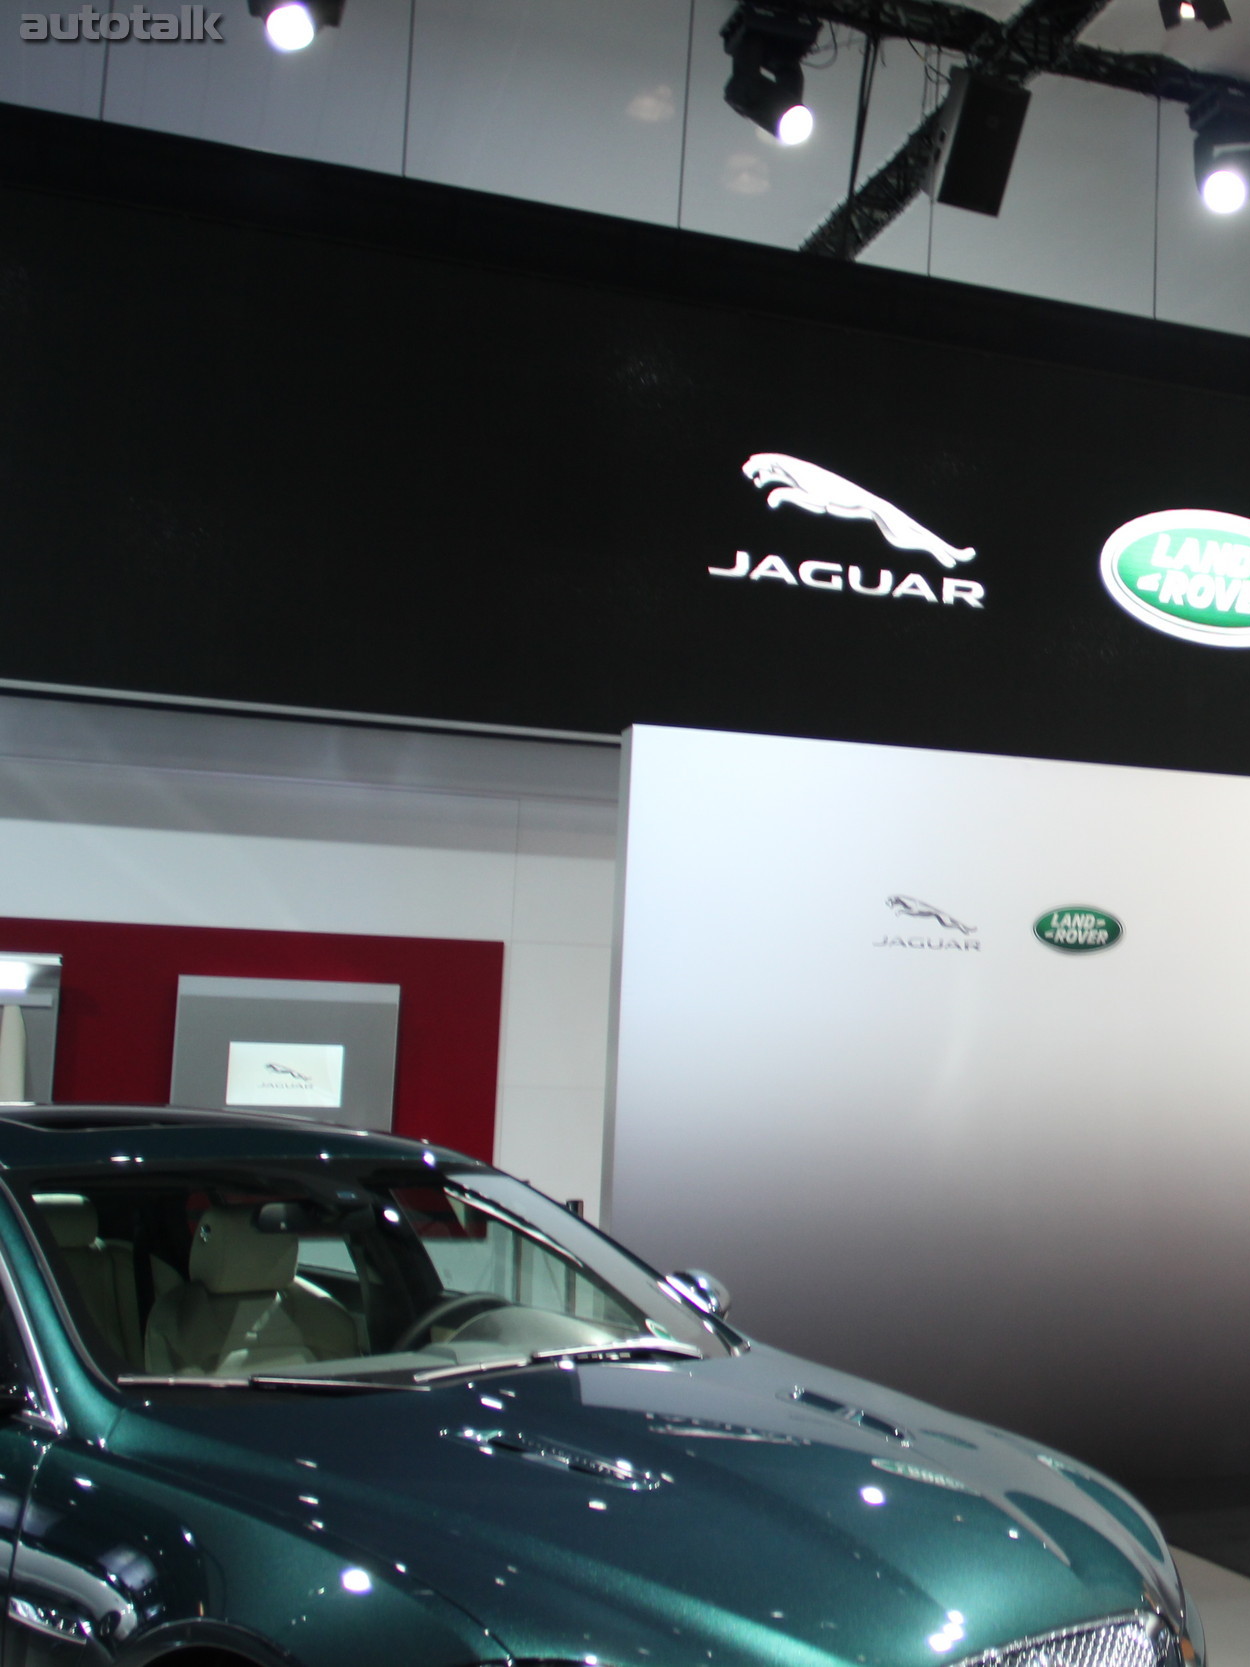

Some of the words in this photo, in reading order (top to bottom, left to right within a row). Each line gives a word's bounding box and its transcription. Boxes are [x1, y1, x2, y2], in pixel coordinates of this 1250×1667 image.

[707, 550, 986, 609] JAGUAR
[1051, 912, 1096, 929] LAND
[872, 934, 981, 951] JAGUAR
[1054, 928, 1109, 945] ROVER
